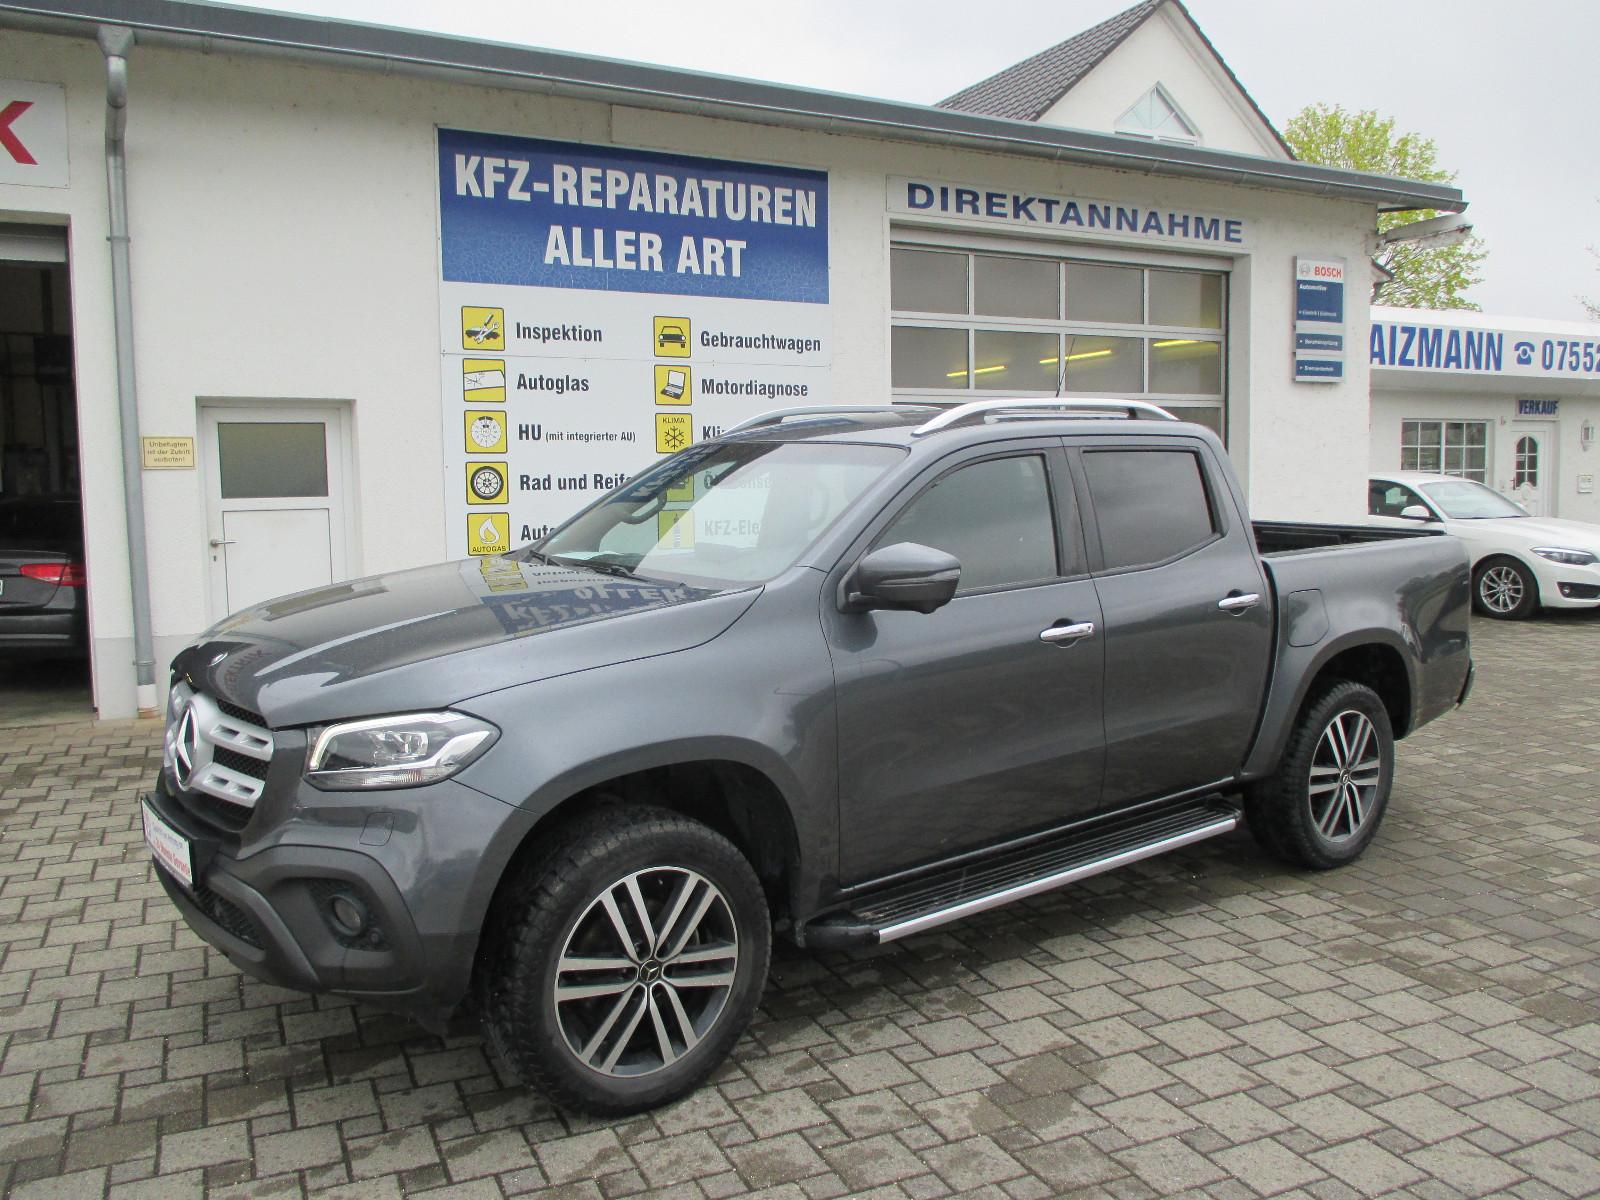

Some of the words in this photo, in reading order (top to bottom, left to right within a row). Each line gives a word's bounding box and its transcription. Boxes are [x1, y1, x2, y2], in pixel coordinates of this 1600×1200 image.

[455, 154, 816, 227] KFZ-REPARATUREN
[906, 182, 1243, 243] DIREKTANNAHME
[543, 225, 664, 272] ALLER
[676, 235, 746, 278] ART
[1314, 266, 1342, 279] BOSCH
[515, 322, 602, 343] Inspektion
[700, 330, 821, 354] Gebrauchtwagen
[1369, 323, 1503, 371] AIZMANN
[516, 374, 590, 393] Autoglas
[701, 379, 809, 398] Motordiagnose
[1519, 400, 1558, 415] VERKAUF
[518, 424, 542, 441] HU
[545, 432, 564, 443] (mit
[566, 432, 618, 443] integrierter
[620, 432, 636, 443] AU)
[702, 425, 727, 441] Kli
[519, 474, 551, 491] Rad
[557, 473, 587, 490] und
[520, 525, 555, 541] Aut
[472, 545, 506, 553] AUTOGAS
